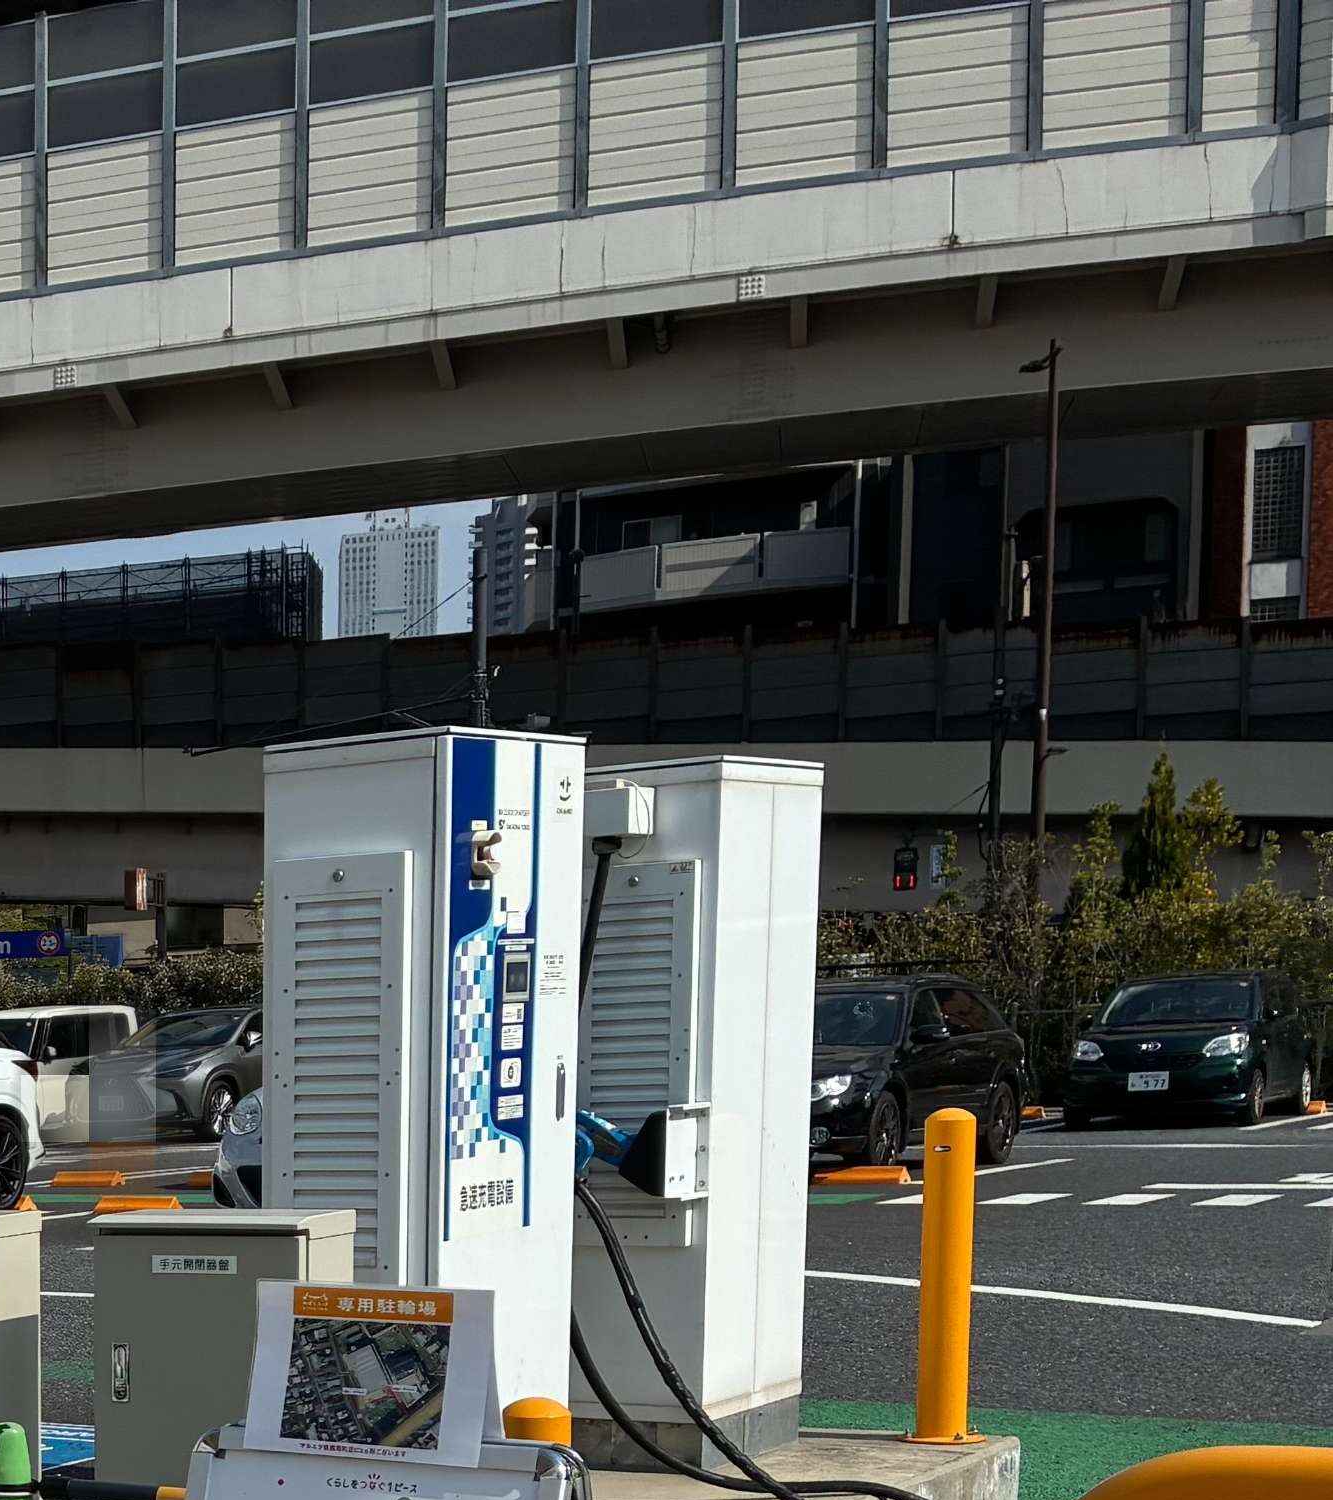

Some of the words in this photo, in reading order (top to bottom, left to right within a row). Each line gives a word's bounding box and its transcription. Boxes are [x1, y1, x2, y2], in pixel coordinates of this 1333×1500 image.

[336, 1296, 438, 1317] 専用駐輪場
